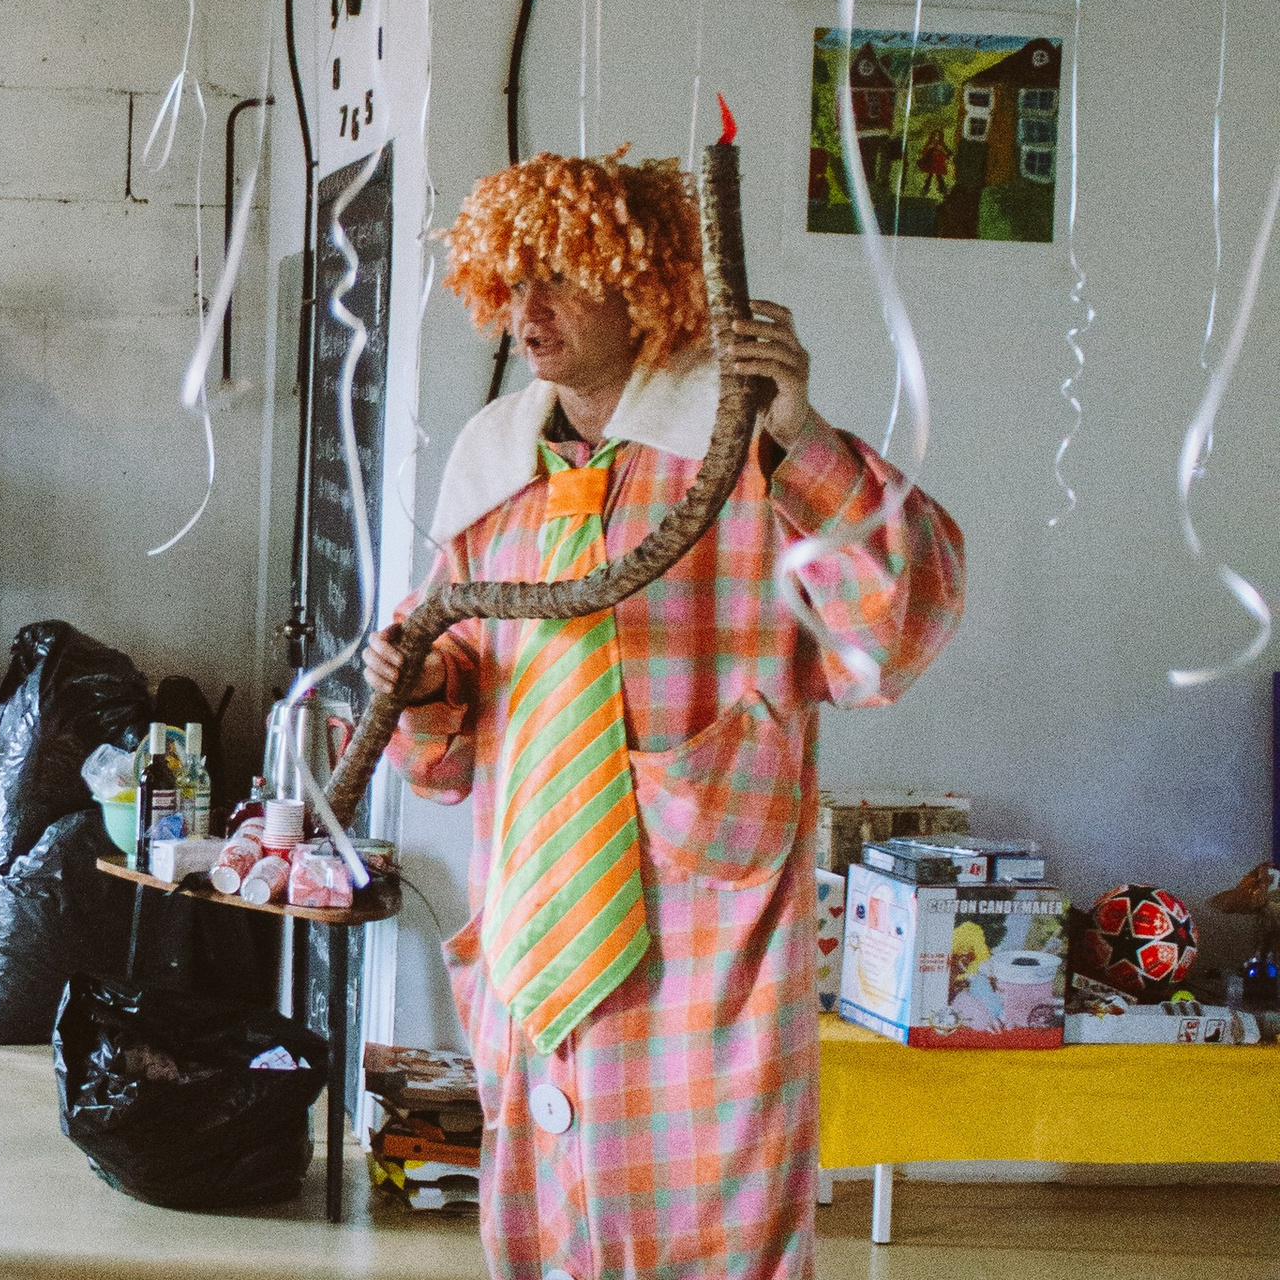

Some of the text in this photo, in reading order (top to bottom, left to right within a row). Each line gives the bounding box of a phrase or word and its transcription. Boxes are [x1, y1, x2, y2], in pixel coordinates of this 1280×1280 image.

[927, 899, 1062, 915] COTTON CANDY MAKER
